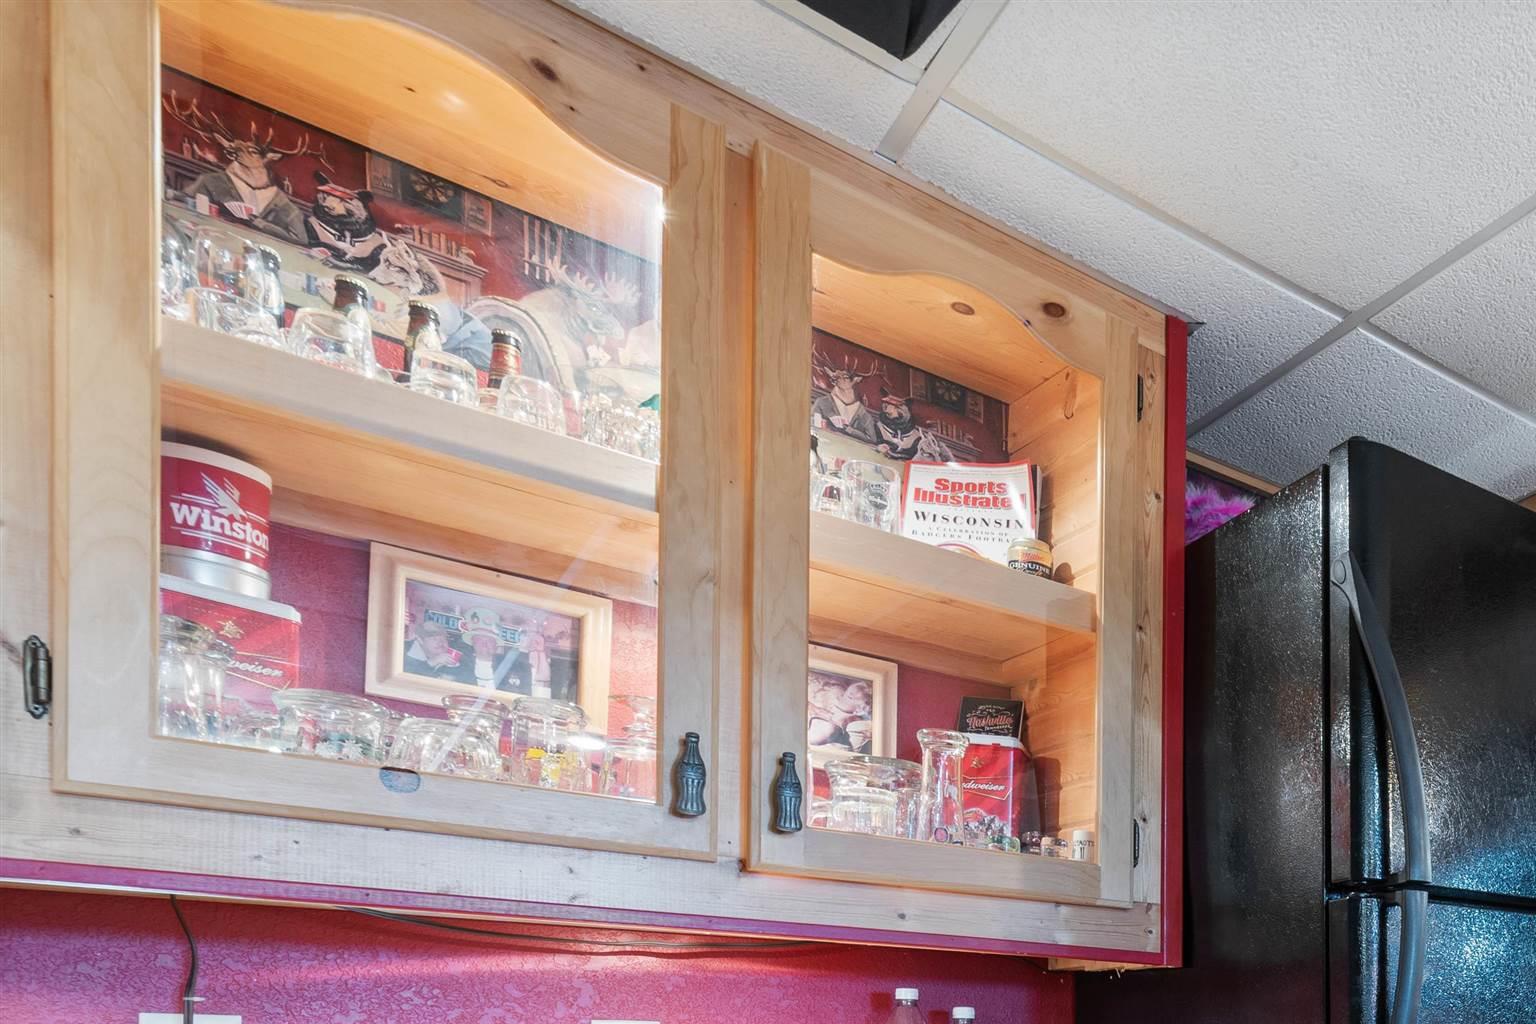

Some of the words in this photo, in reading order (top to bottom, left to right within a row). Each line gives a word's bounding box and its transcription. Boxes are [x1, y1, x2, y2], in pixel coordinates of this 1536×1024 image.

[934, 478, 1008, 495] Sports
[169, 501, 270, 551] Winston
[914, 510, 1024, 530] WISCONSIN
[968, 534, 1011, 544] FOOTBA
